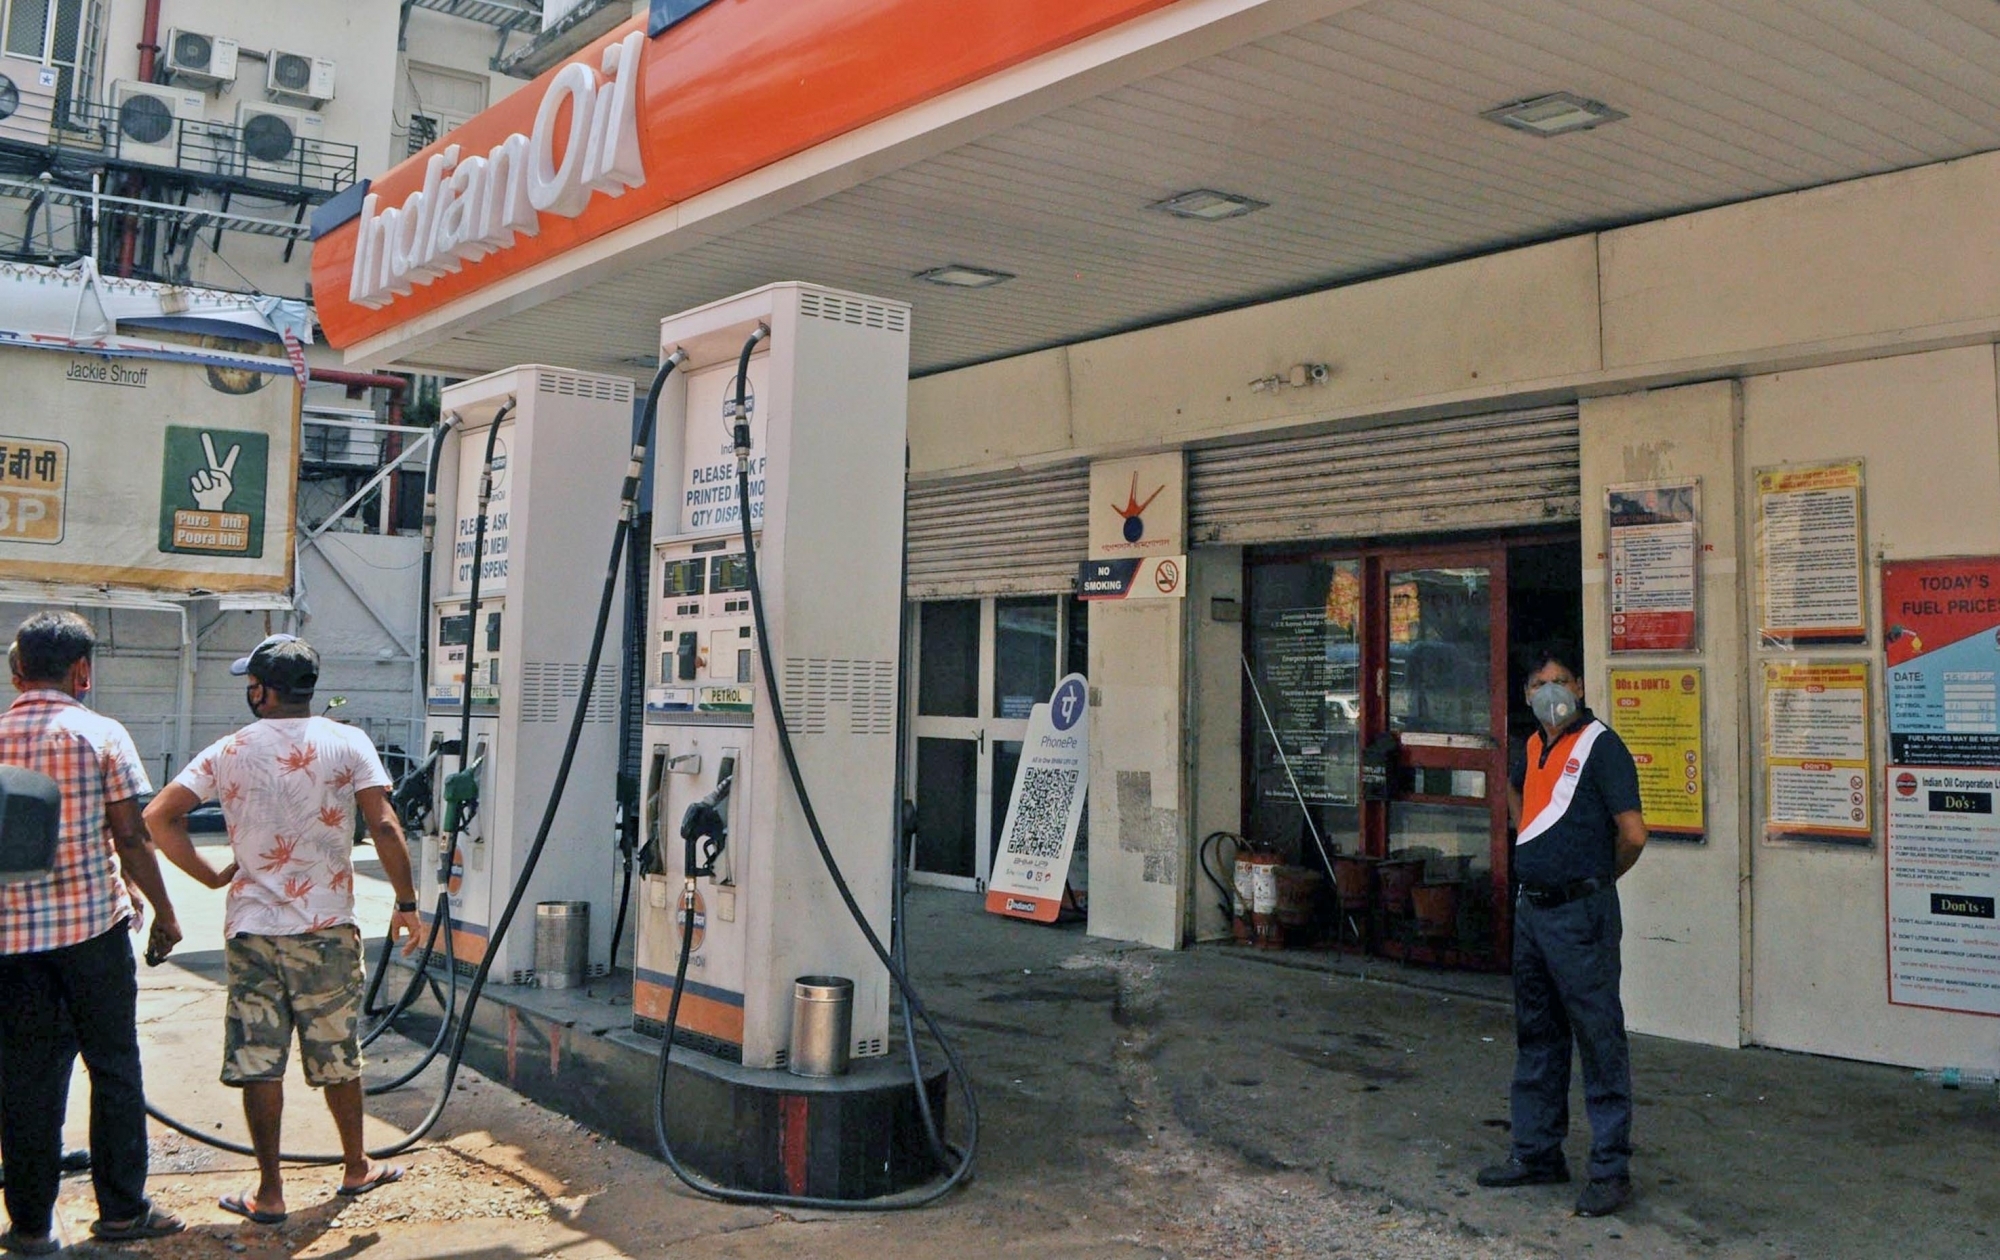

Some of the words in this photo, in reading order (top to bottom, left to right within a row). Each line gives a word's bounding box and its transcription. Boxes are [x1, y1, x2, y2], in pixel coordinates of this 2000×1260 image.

[349, 30, 646, 310] IndianOil
[67, 360, 106, 381] Jackie
[110, 364, 147, 384] Shroff
[692, 463, 733, 485] PLEASE
[735, 458, 756, 479] AK
[686, 484, 731, 507] PRINTED
[735, 480, 765, 500] MMO
[178, 511, 210, 527] Pure
[460, 515, 488, 536] PLEAE
[492, 512, 508, 531] ASK
[691, 507, 713, 527] QTY
[177, 530, 216, 545] Poora
[1098, 566, 1110, 576] NO
[1084, 580, 1121, 591] SMOKING
[1920, 574, 1989, 591] TODAY'S
[1902, 600, 1942, 616] FUEL
[1616, 678, 1632, 690] DOs
[1634, 680, 1639, 690] &
[1894, 672, 1924, 682] DATE:
[435, 687, 453, 697] DIESEL
[472, 686, 493, 697] PETROL
[711, 689, 742, 702] PETROL
[1061, 685, 1078, 724] पे
[1621, 698, 1635, 706] DOs
[1040, 735, 1078, 749] PhonePe
[1922, 776, 1942, 787] Indian
[1944, 777, 1953, 787] Oil
[1954, 777, 1993, 790] Corporation
[1945, 795, 1970, 809] Do's
[1941, 899, 1979, 913] Don'ts
